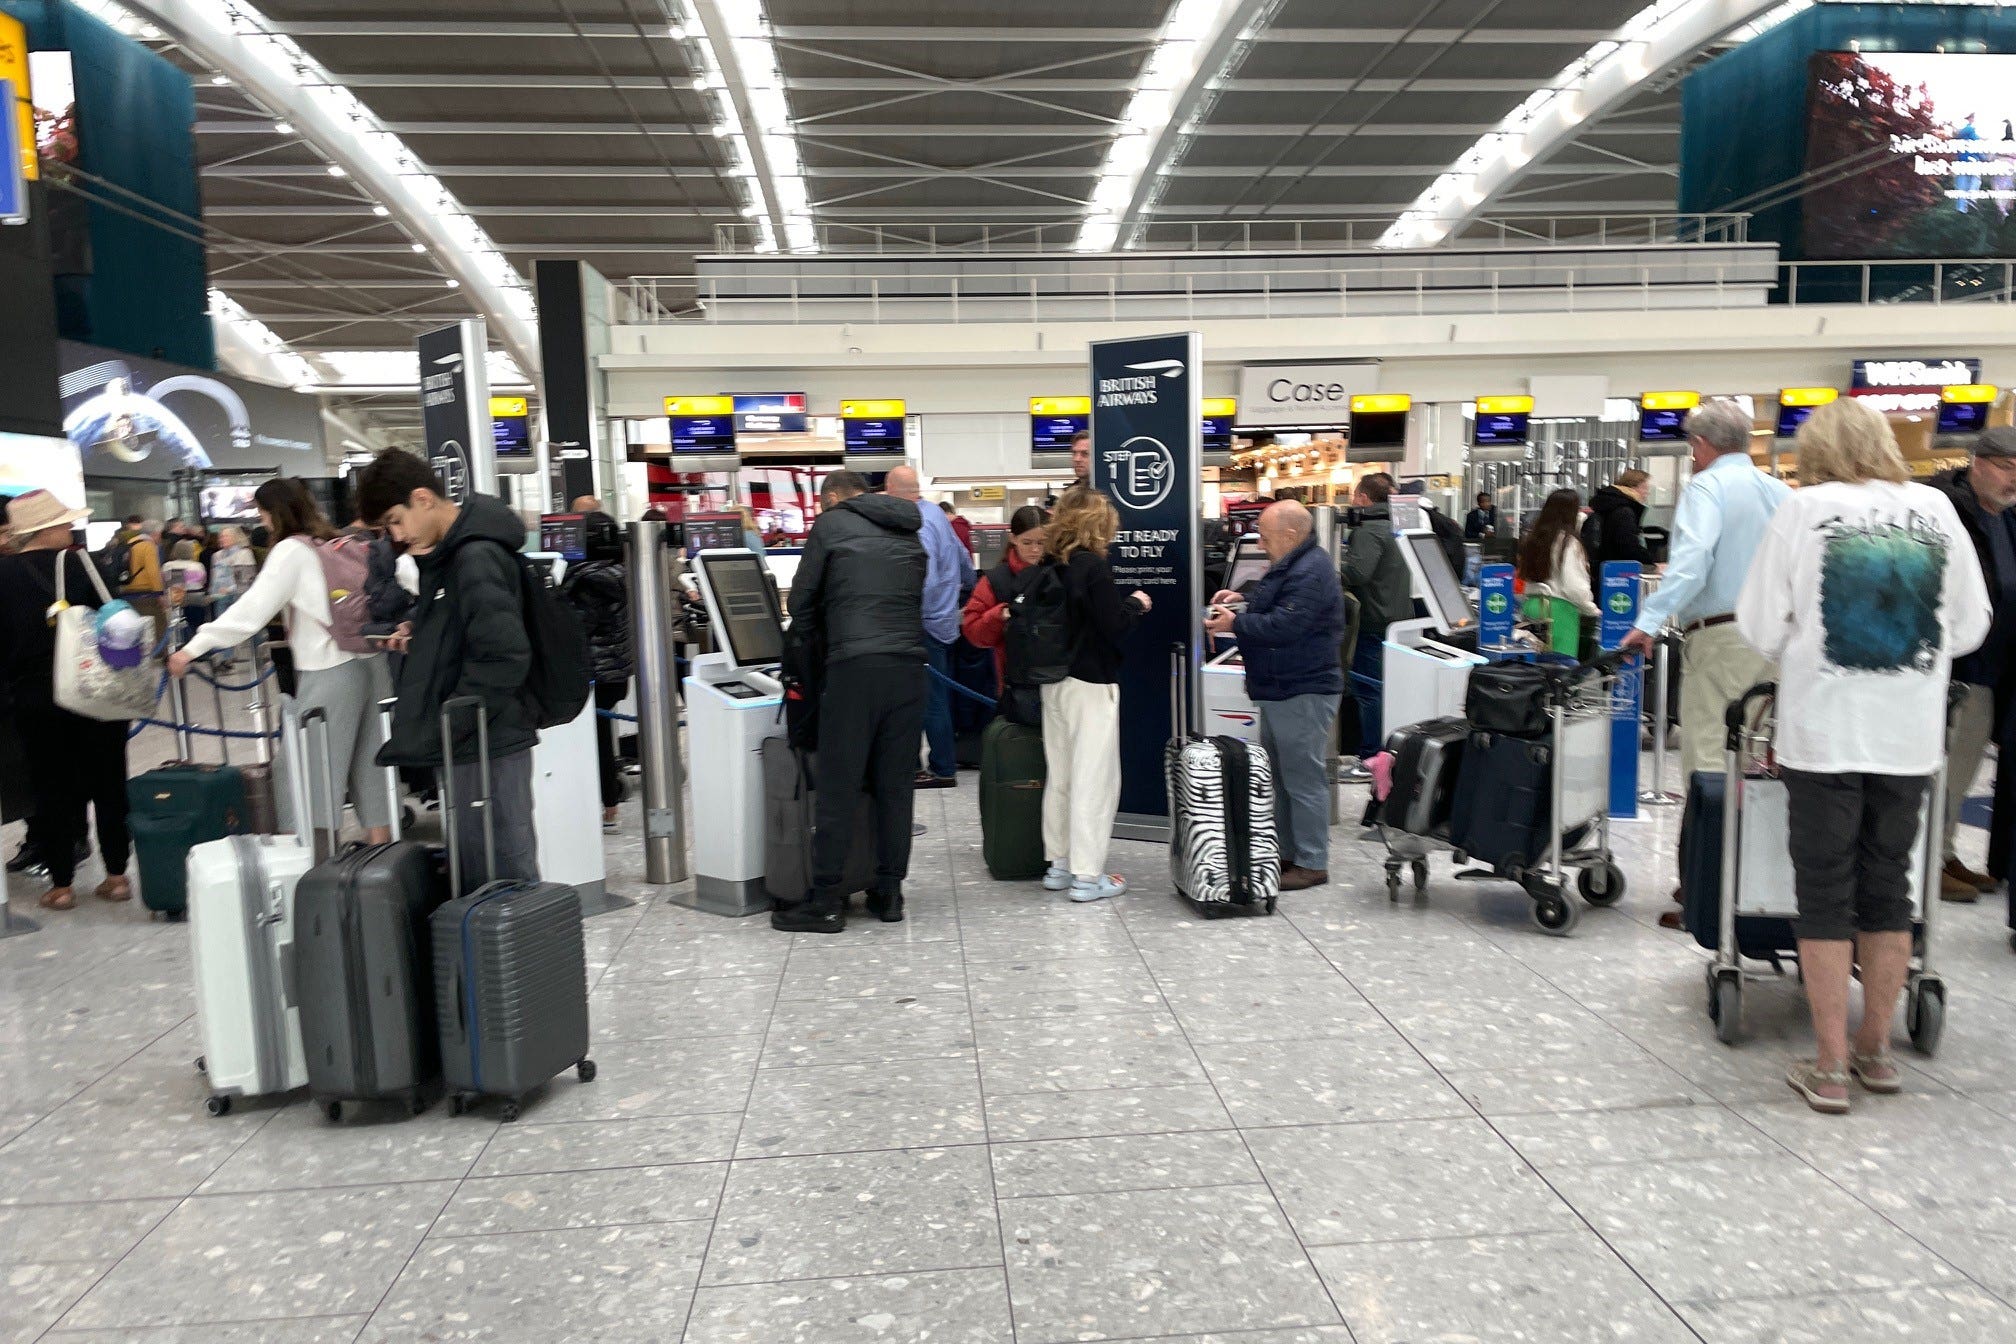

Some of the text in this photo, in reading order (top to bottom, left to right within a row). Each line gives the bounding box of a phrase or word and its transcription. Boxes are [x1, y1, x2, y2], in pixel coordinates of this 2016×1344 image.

[1100, 376, 1156, 392] BRITISH
[1267, 379, 1344, 402] Case
[1097, 390, 1158, 407] AIRWAYS
[1103, 450, 1132, 462] STEP
[1109, 462, 1117, 479] 1
[1133, 529, 1180, 542] READY
[1118, 545, 1165, 558] TO FLY
